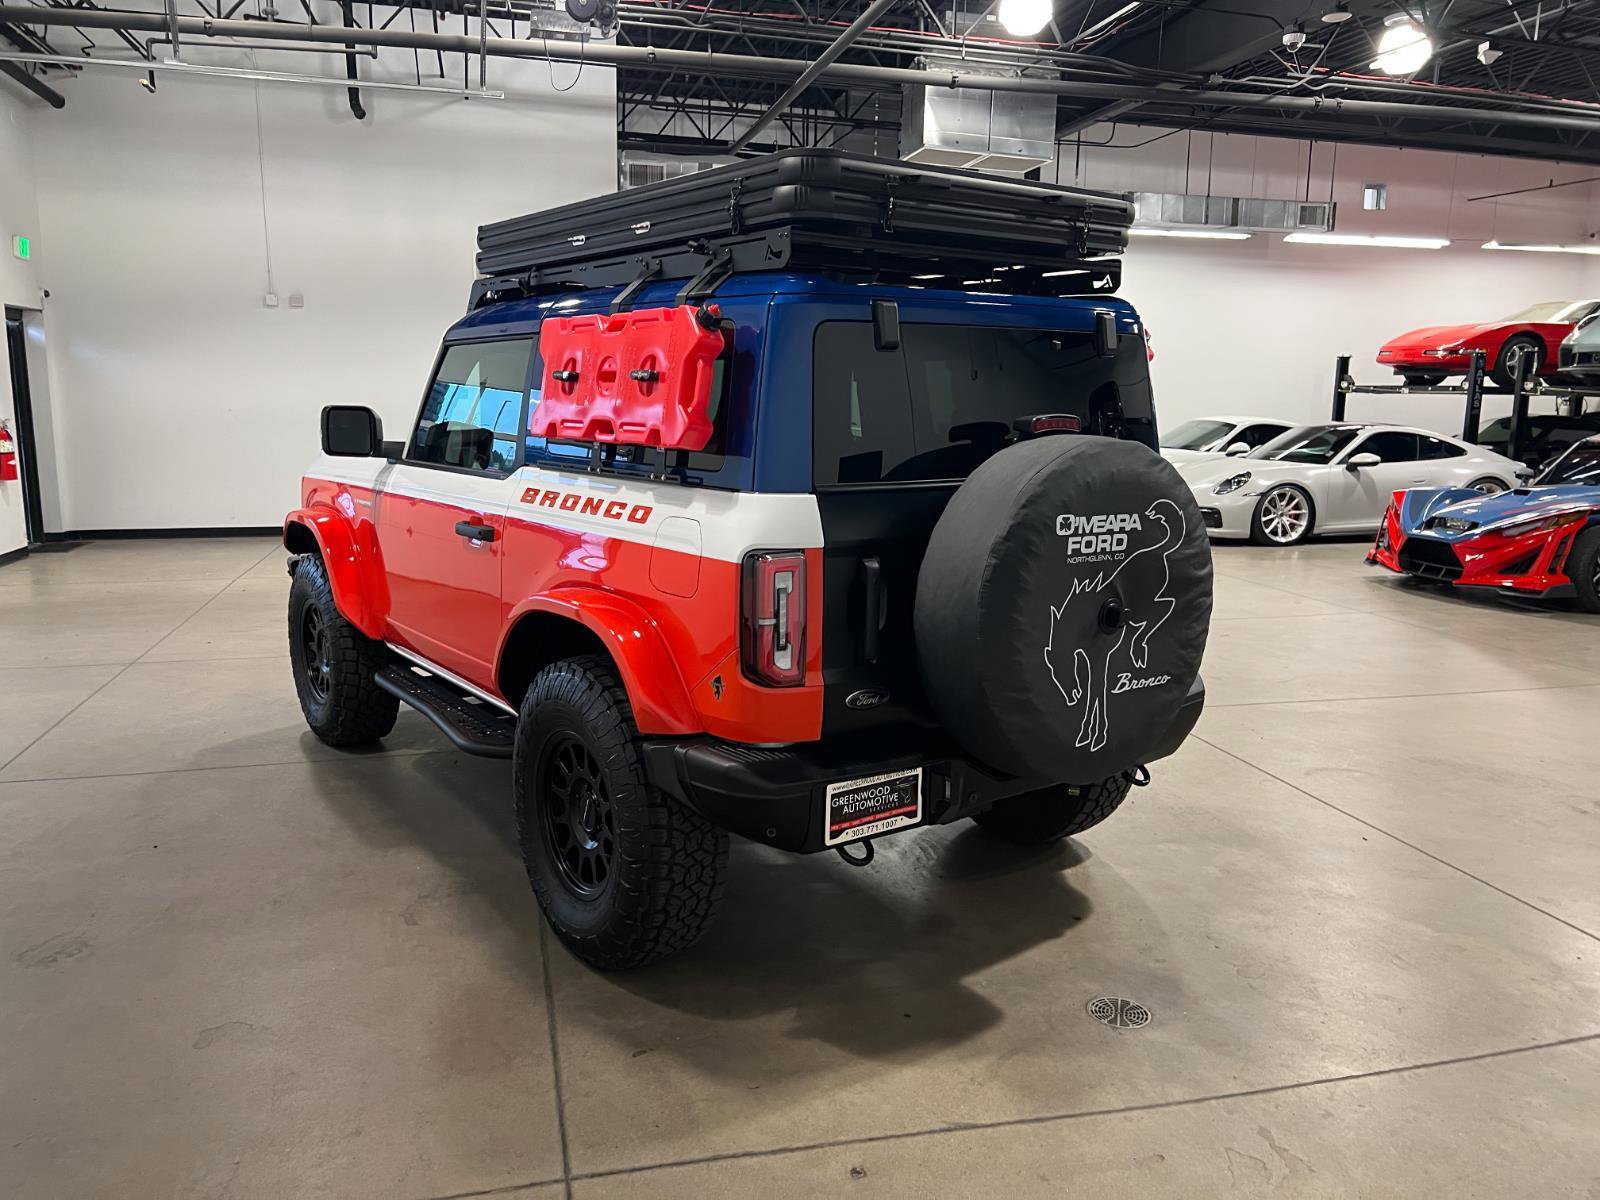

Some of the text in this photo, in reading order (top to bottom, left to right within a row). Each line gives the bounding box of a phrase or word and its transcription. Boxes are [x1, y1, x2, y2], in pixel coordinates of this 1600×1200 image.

[1473, 369, 1484, 408] ATLAS
[520, 487, 653, 524] BRONCO
[1067, 533, 1128, 555] FORD
[1111, 672, 1171, 693] Bronco
[856, 693, 880, 706] Ford
[831, 785, 891, 808] GREENWOOD
[842, 792, 899, 815] AUTOMOTIVE
[851, 819, 898, 838] 303.771.1007
